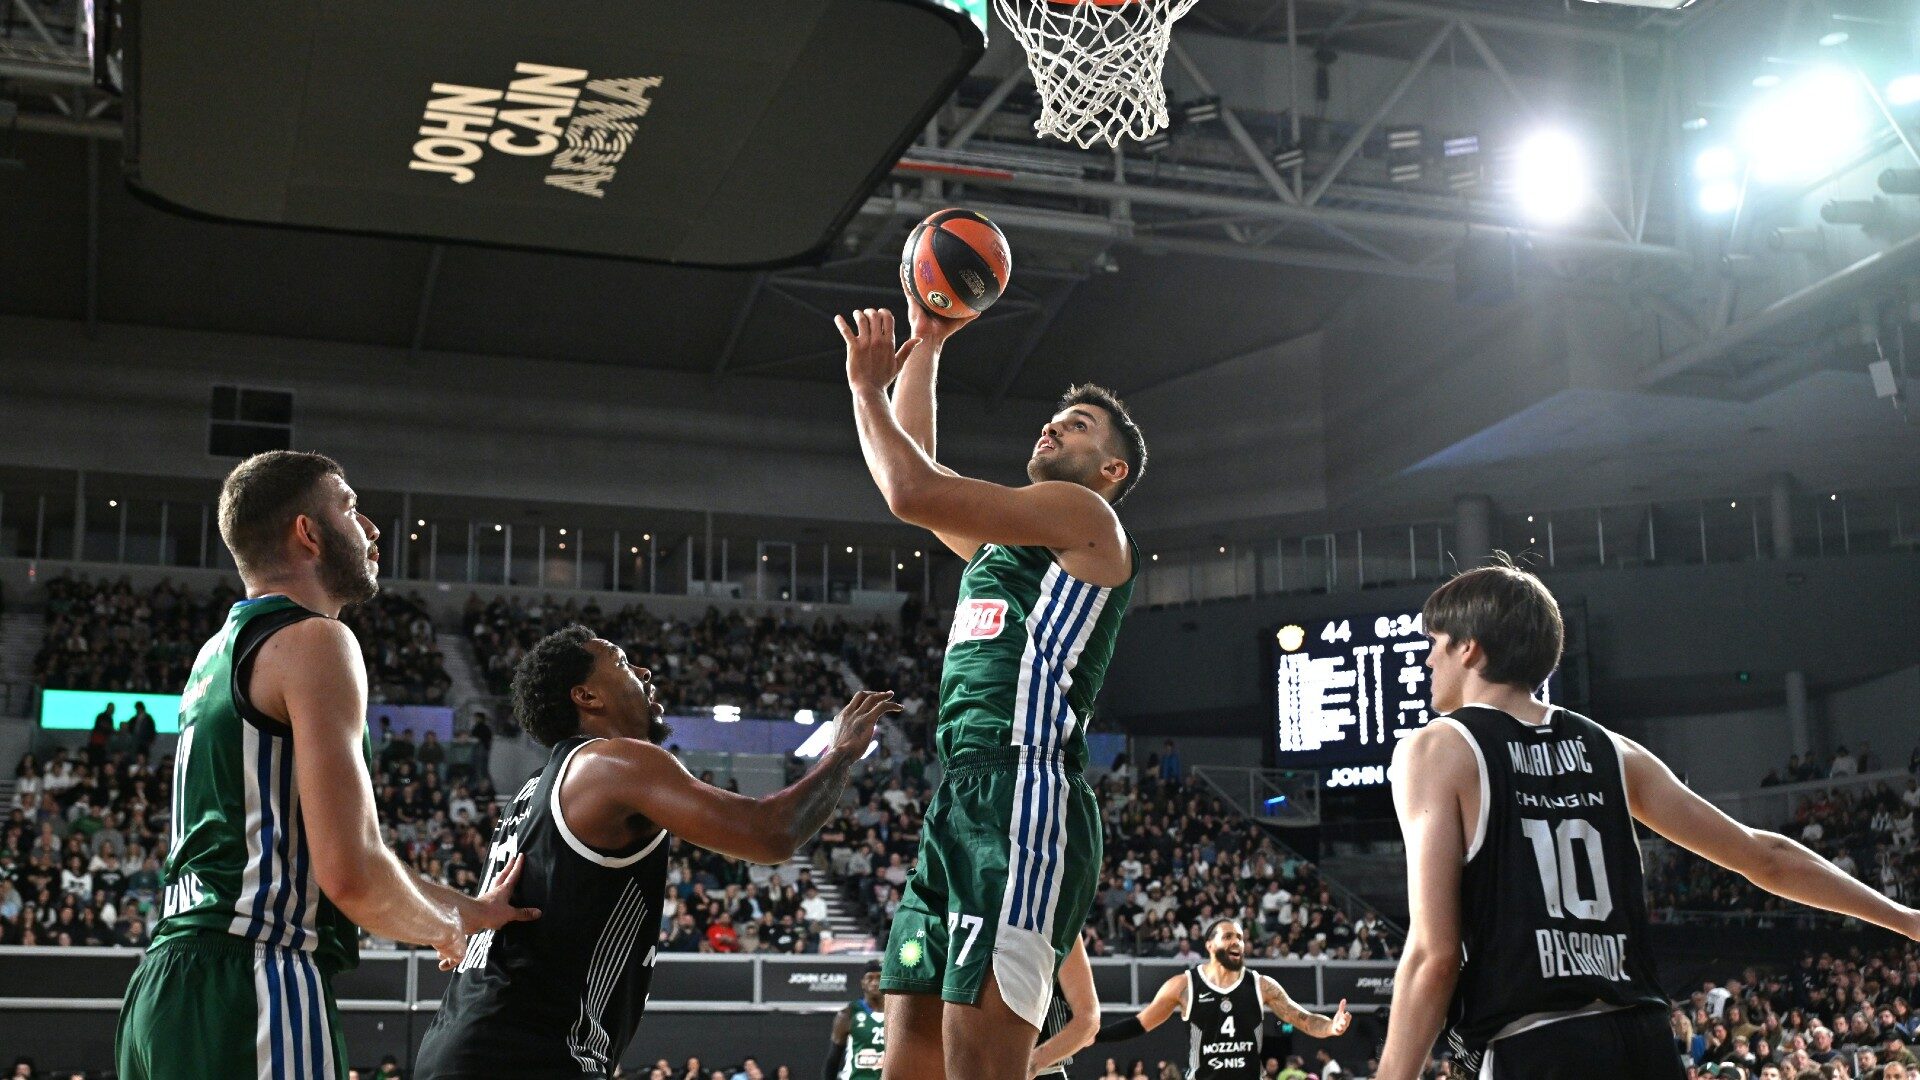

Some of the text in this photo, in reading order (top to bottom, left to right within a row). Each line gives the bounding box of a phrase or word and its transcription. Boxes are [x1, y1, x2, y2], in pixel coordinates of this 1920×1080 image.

[488, 61, 589, 157] CAIN
[408, 82, 504, 184] JOHN
[544, 75, 664, 198] ARENA
[1320, 619, 1352, 644] 44
[1326, 765, 1385, 788] JOHN
[1520, 817, 1614, 922] 10
[1535, 928, 1632, 982] BELGRADE
[1220, 1015, 1236, 1038] 4
[1203, 1041, 1254, 1056] MOZZART
[1224, 1056, 1246, 1069] NIS
